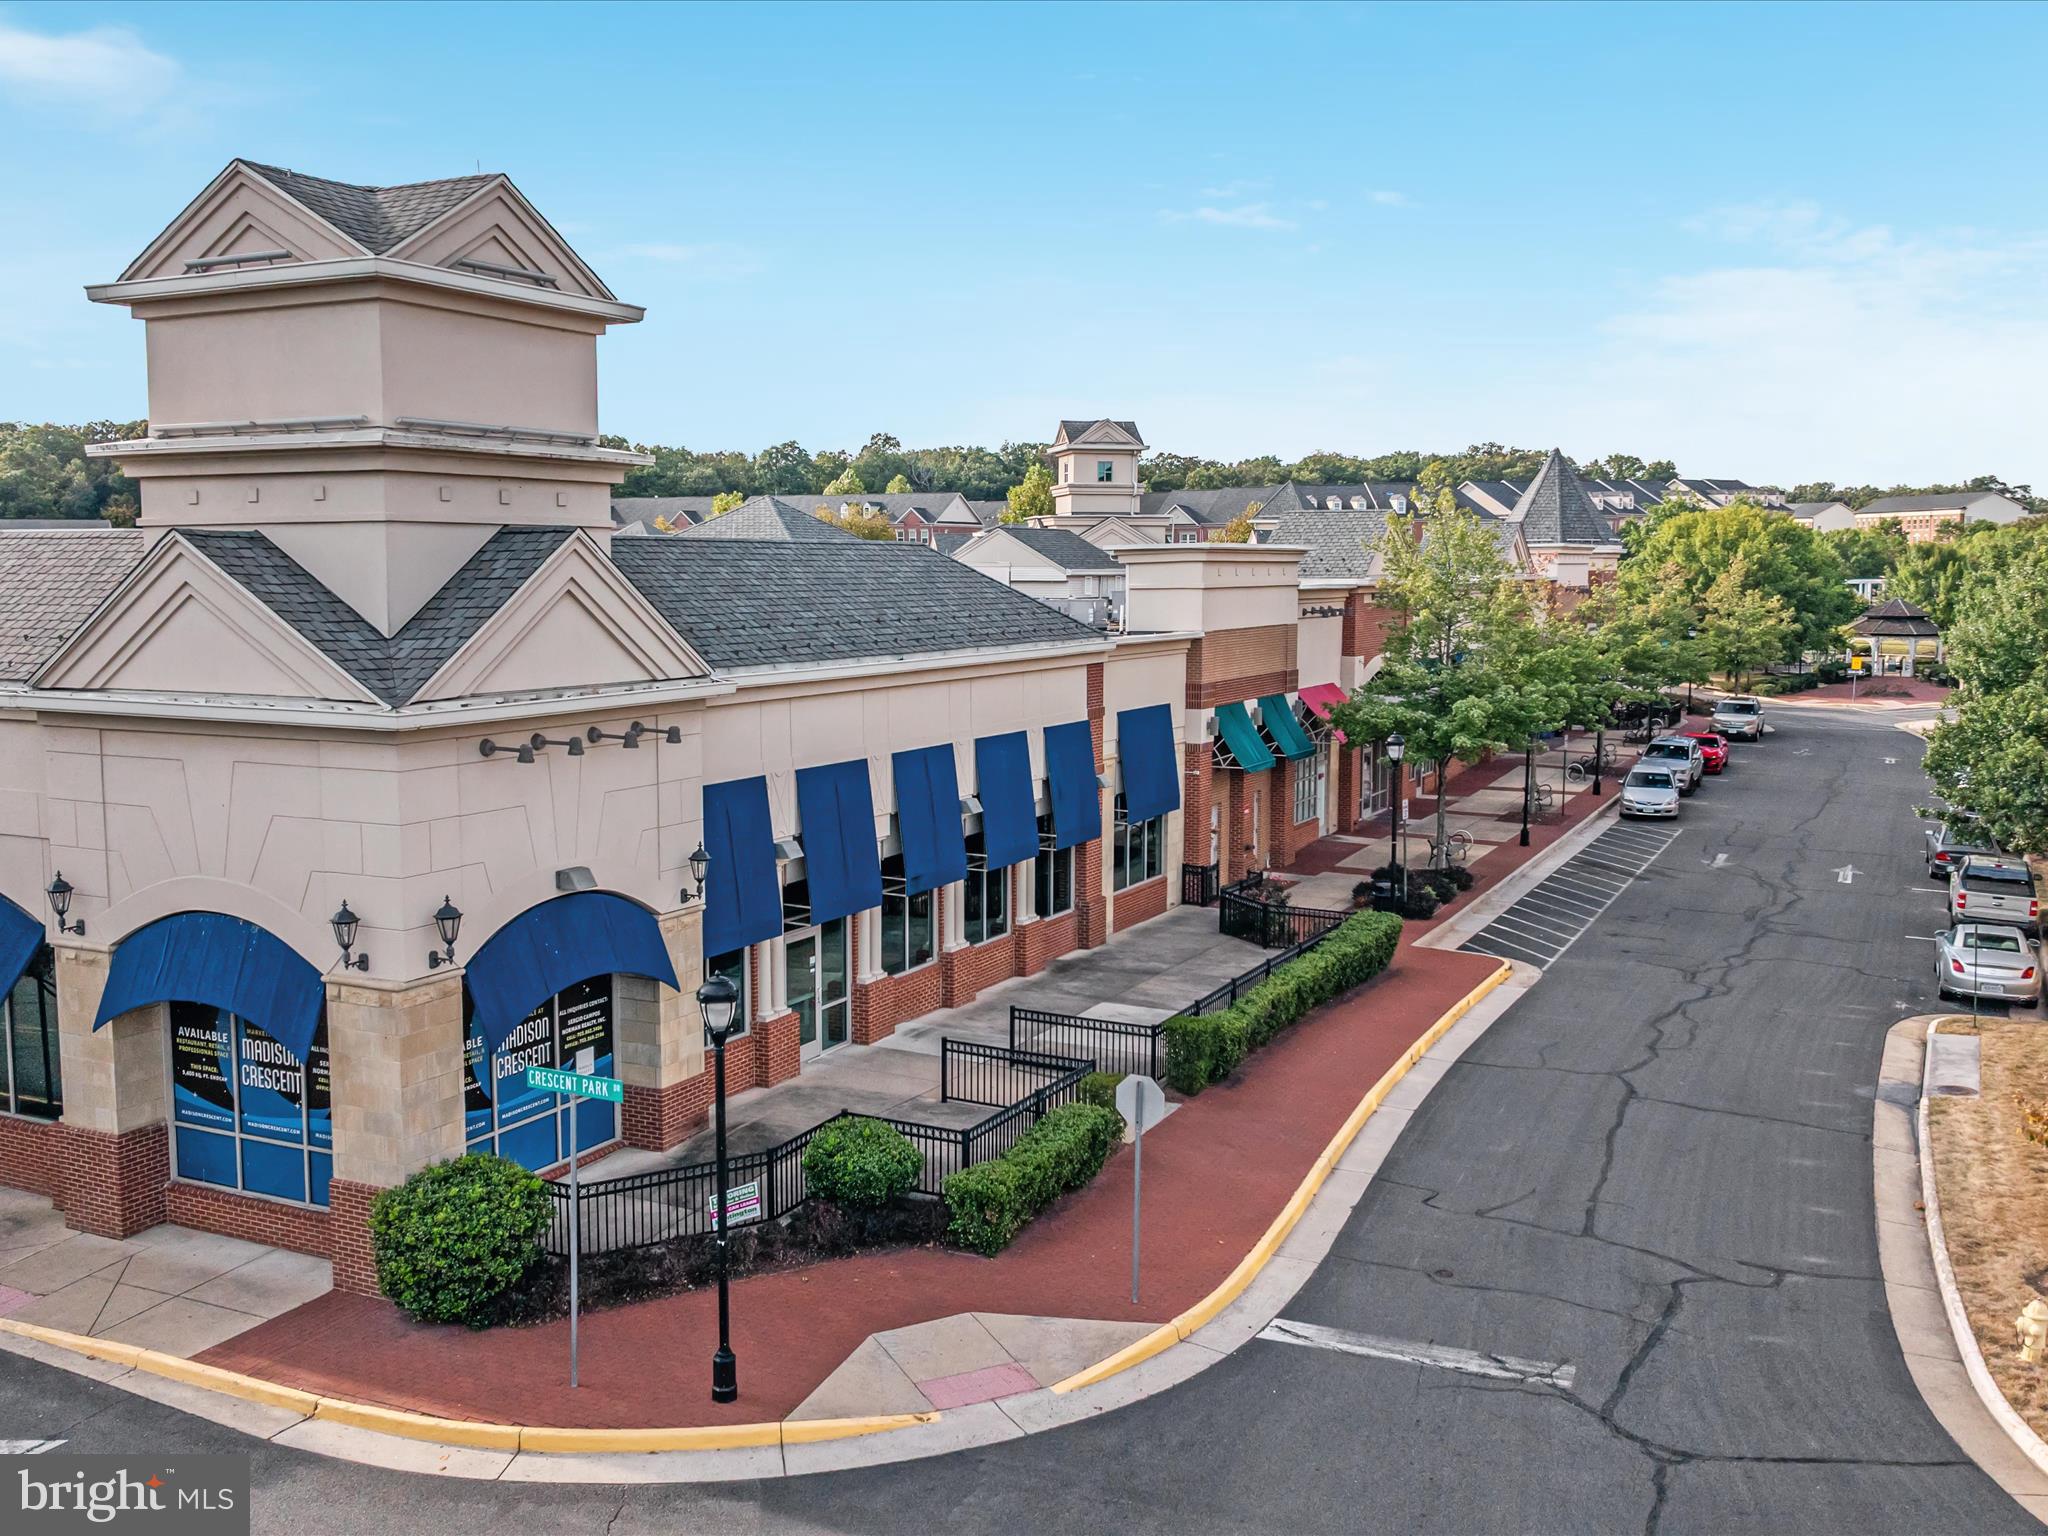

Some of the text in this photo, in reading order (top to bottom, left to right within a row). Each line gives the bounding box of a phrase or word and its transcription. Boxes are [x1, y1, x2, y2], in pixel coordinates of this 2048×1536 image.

[178, 1026, 228, 1043] AVAILABLE
[497, 1042, 551, 1080] CRESCENT
[242, 1065, 301, 1094] CRESCENT
[529, 1070, 620, 1097] CRESCENT PARK DR
